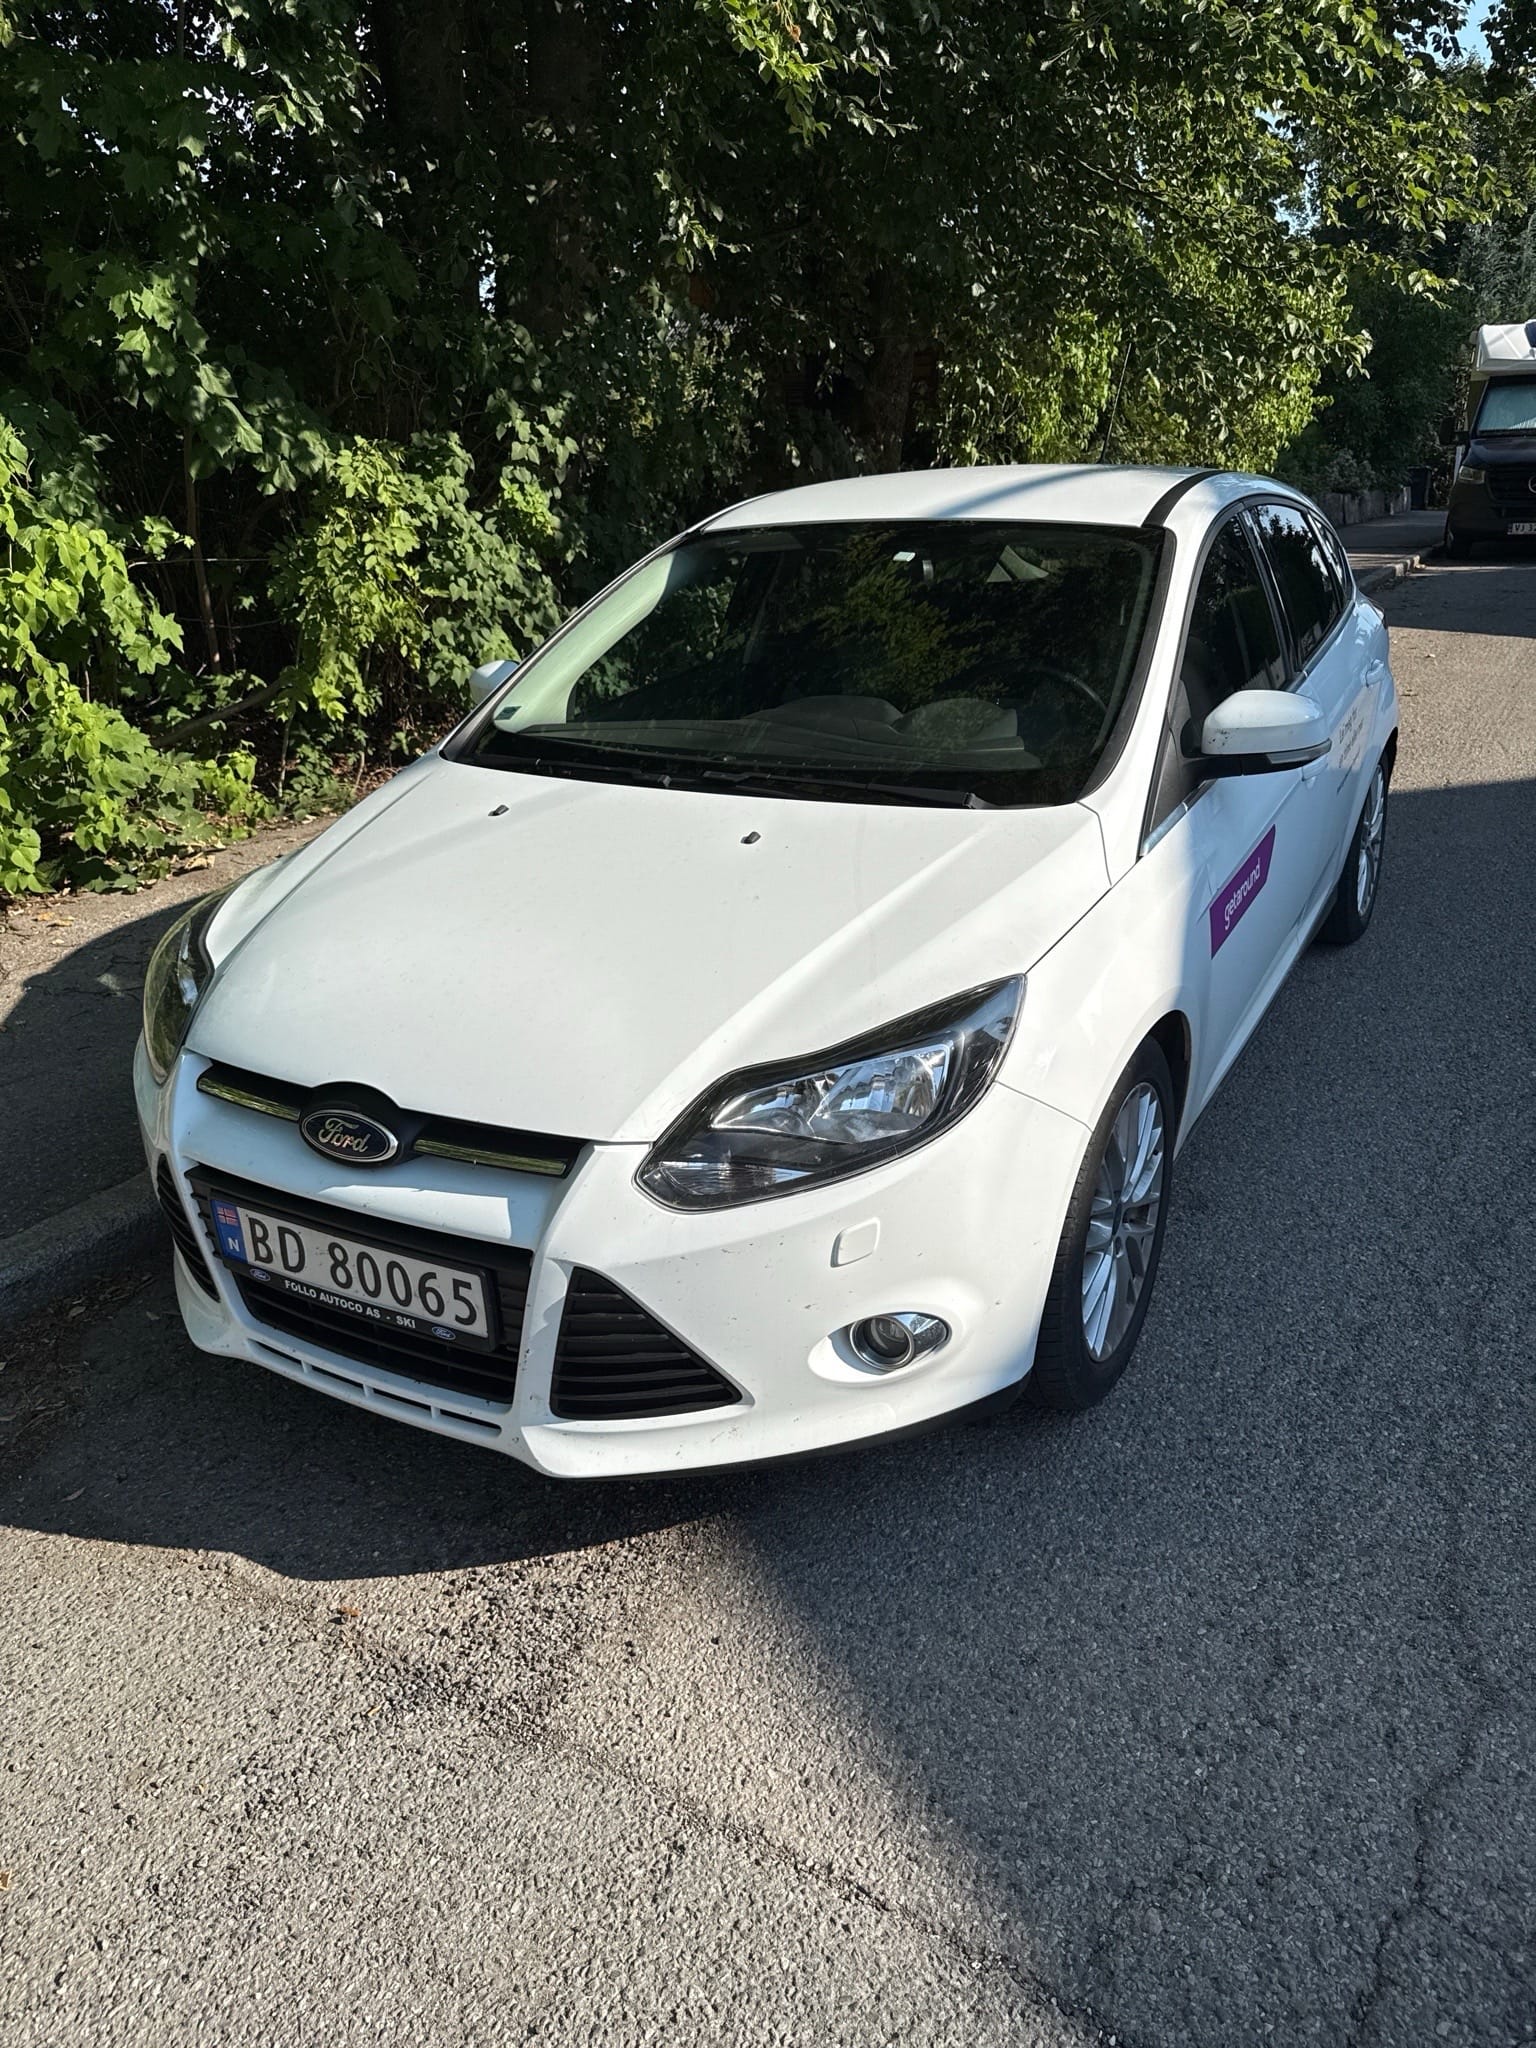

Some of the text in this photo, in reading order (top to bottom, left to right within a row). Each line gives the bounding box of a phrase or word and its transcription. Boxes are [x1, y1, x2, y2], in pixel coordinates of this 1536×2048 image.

[1224, 856, 1262, 931] getaround
[318, 1117, 371, 1153] Ford
[228, 1237, 240, 1252] N
[248, 1217, 477, 1326] BD 80065
[284, 1280, 317, 1298] FOLLO
[319, 1292, 363, 1313] AUTOCO
[366, 1308, 381, 1319] AS
[396, 1315, 416, 1329] SKI
